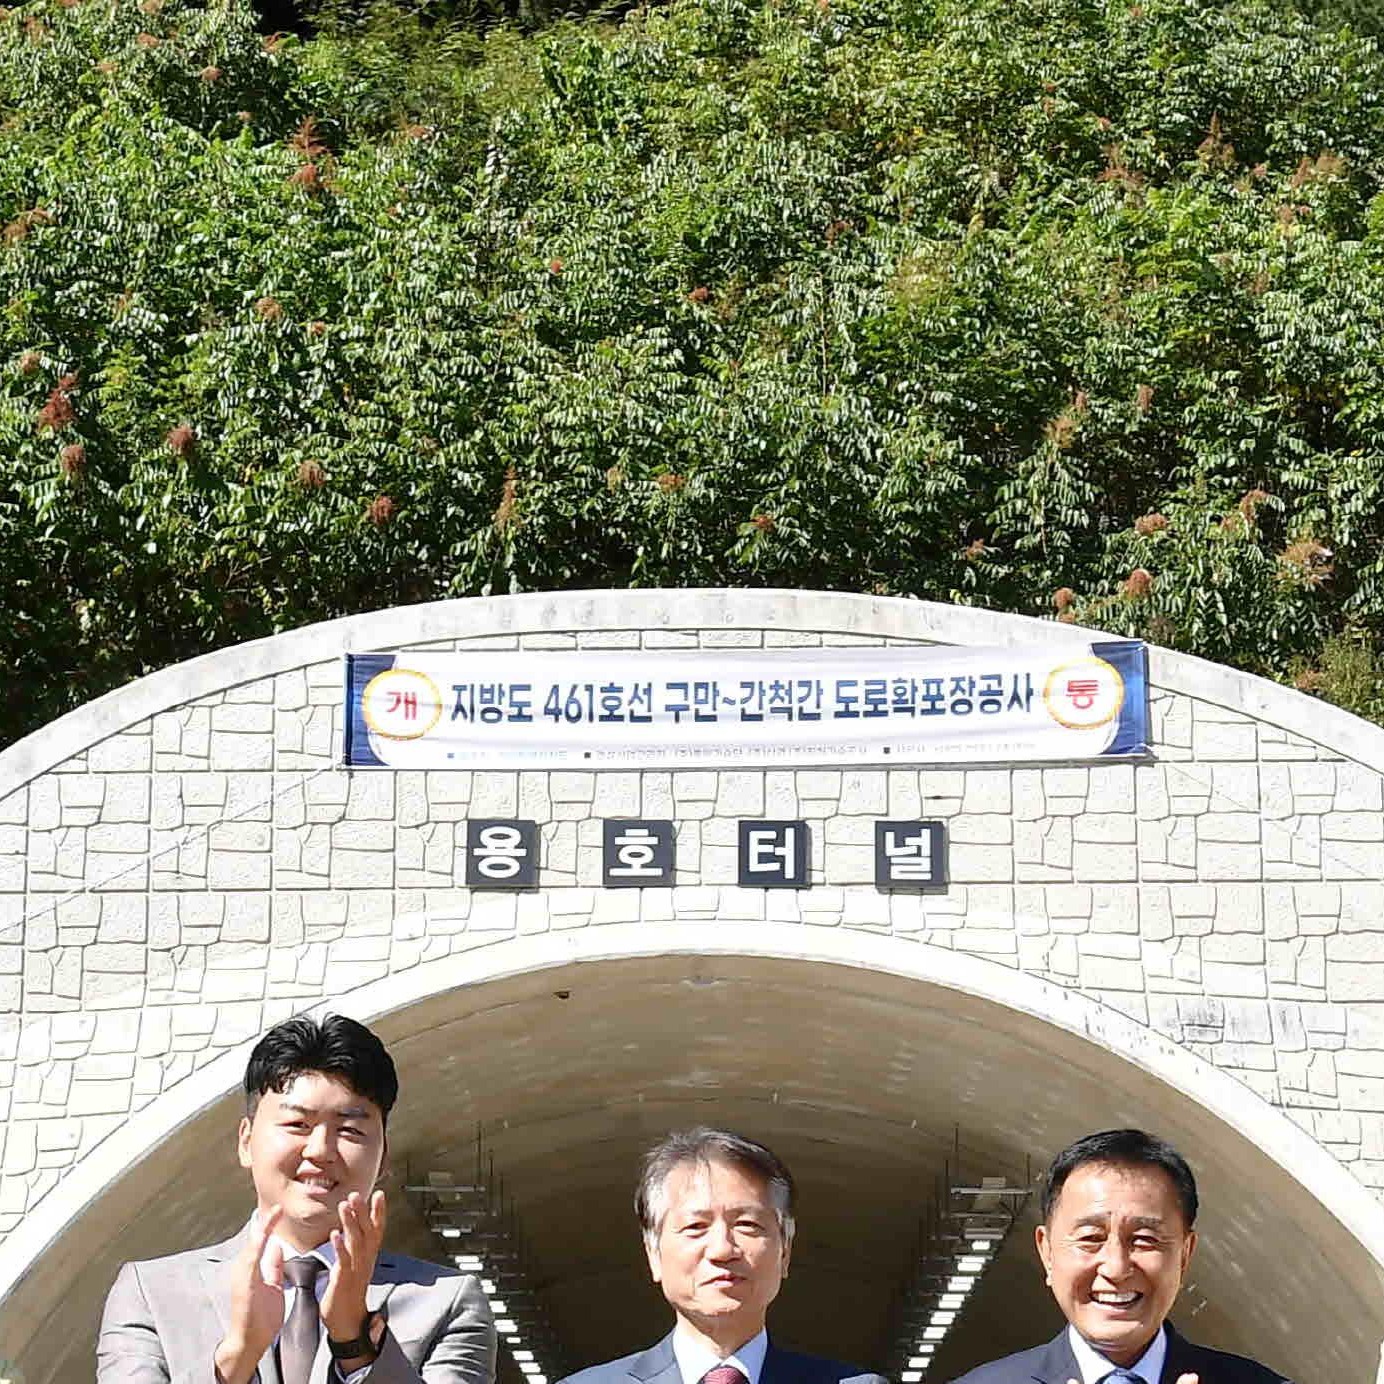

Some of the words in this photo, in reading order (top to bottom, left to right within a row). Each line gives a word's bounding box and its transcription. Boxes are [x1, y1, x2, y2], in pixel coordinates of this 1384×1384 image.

[385, 691, 418, 721] 개
[450, 682, 534, 724] 지방도
[543, 681, 654, 724] 461호선
[664, 679, 824, 724] 구만~간척간
[832, 671, 1034, 720] 도로확포장공사
[1065, 678, 1101, 710] 통
[472, 824, 933, 881] 용호터널
